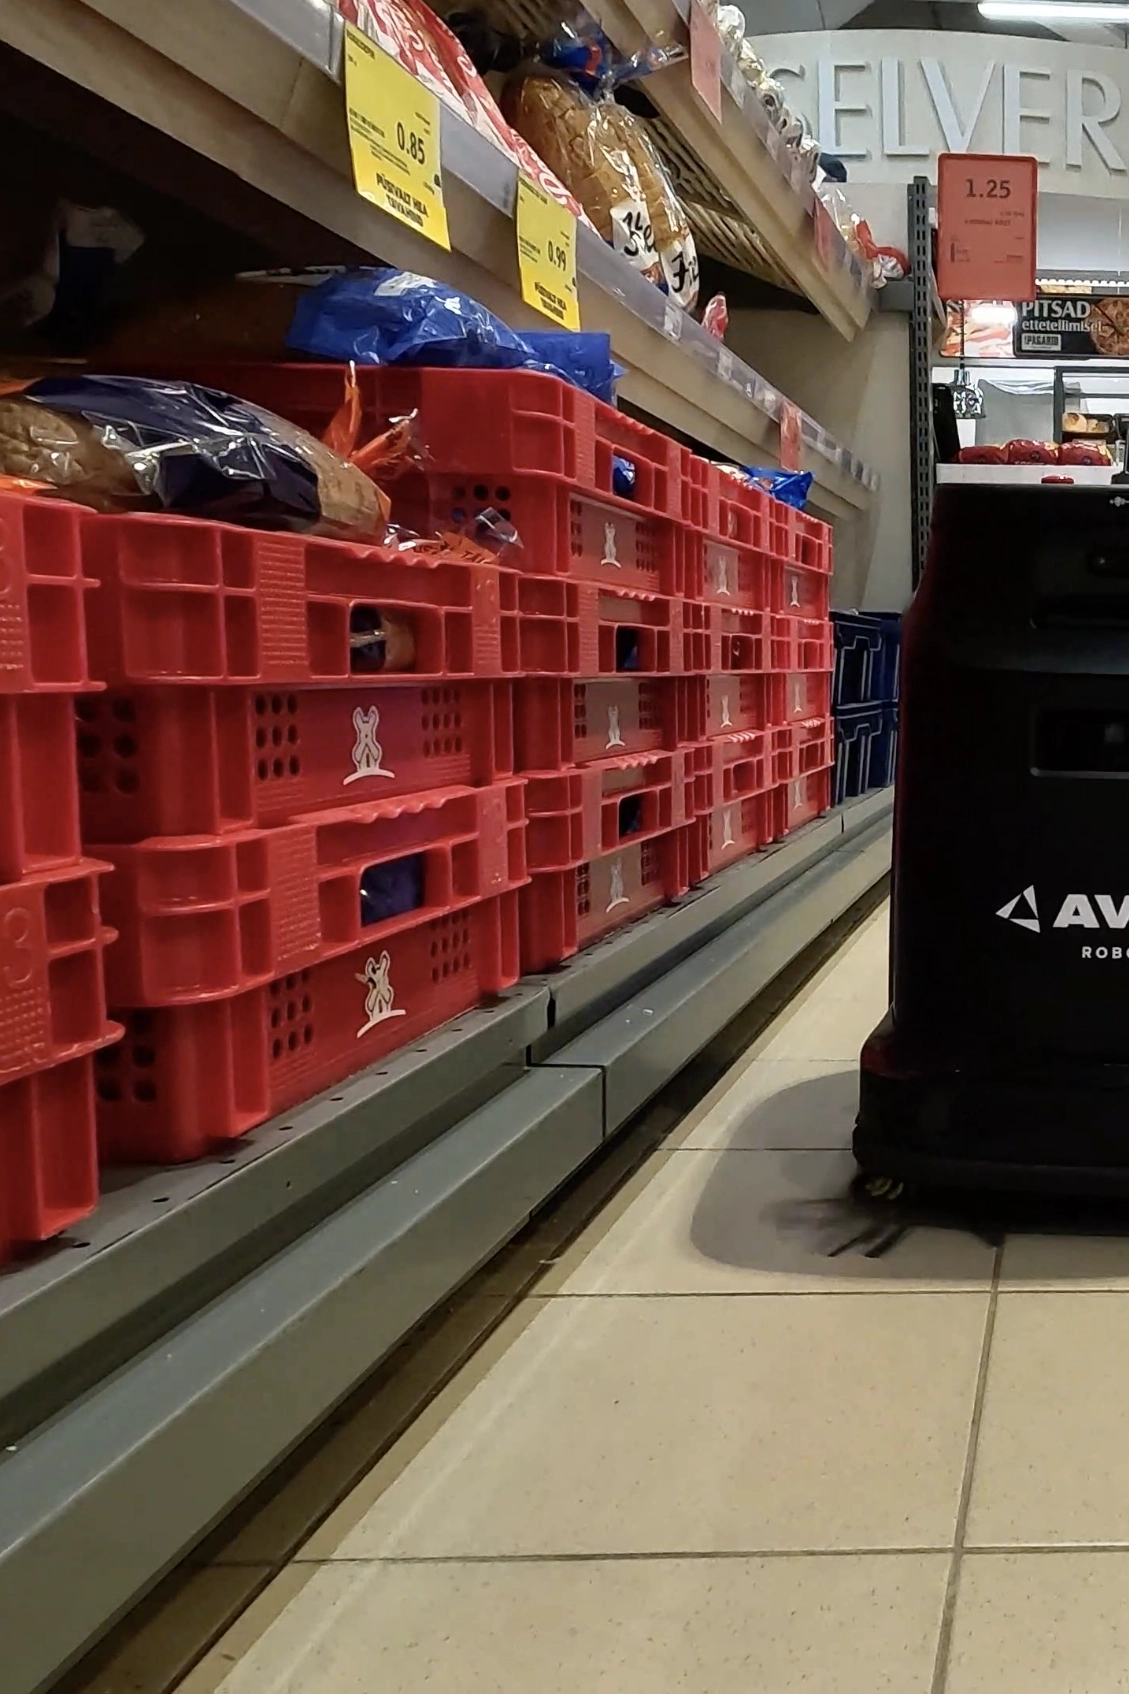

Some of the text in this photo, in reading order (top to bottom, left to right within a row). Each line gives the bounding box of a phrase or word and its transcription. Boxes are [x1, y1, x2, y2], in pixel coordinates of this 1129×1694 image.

[396, 121, 425, 165] 0.85
[965, 178, 1012, 199] 1.25
[547, 240, 567, 272] 0.99
[1021, 300, 1092, 318] PITSAD
[1021, 319, 1102, 333] ettetellimisel
